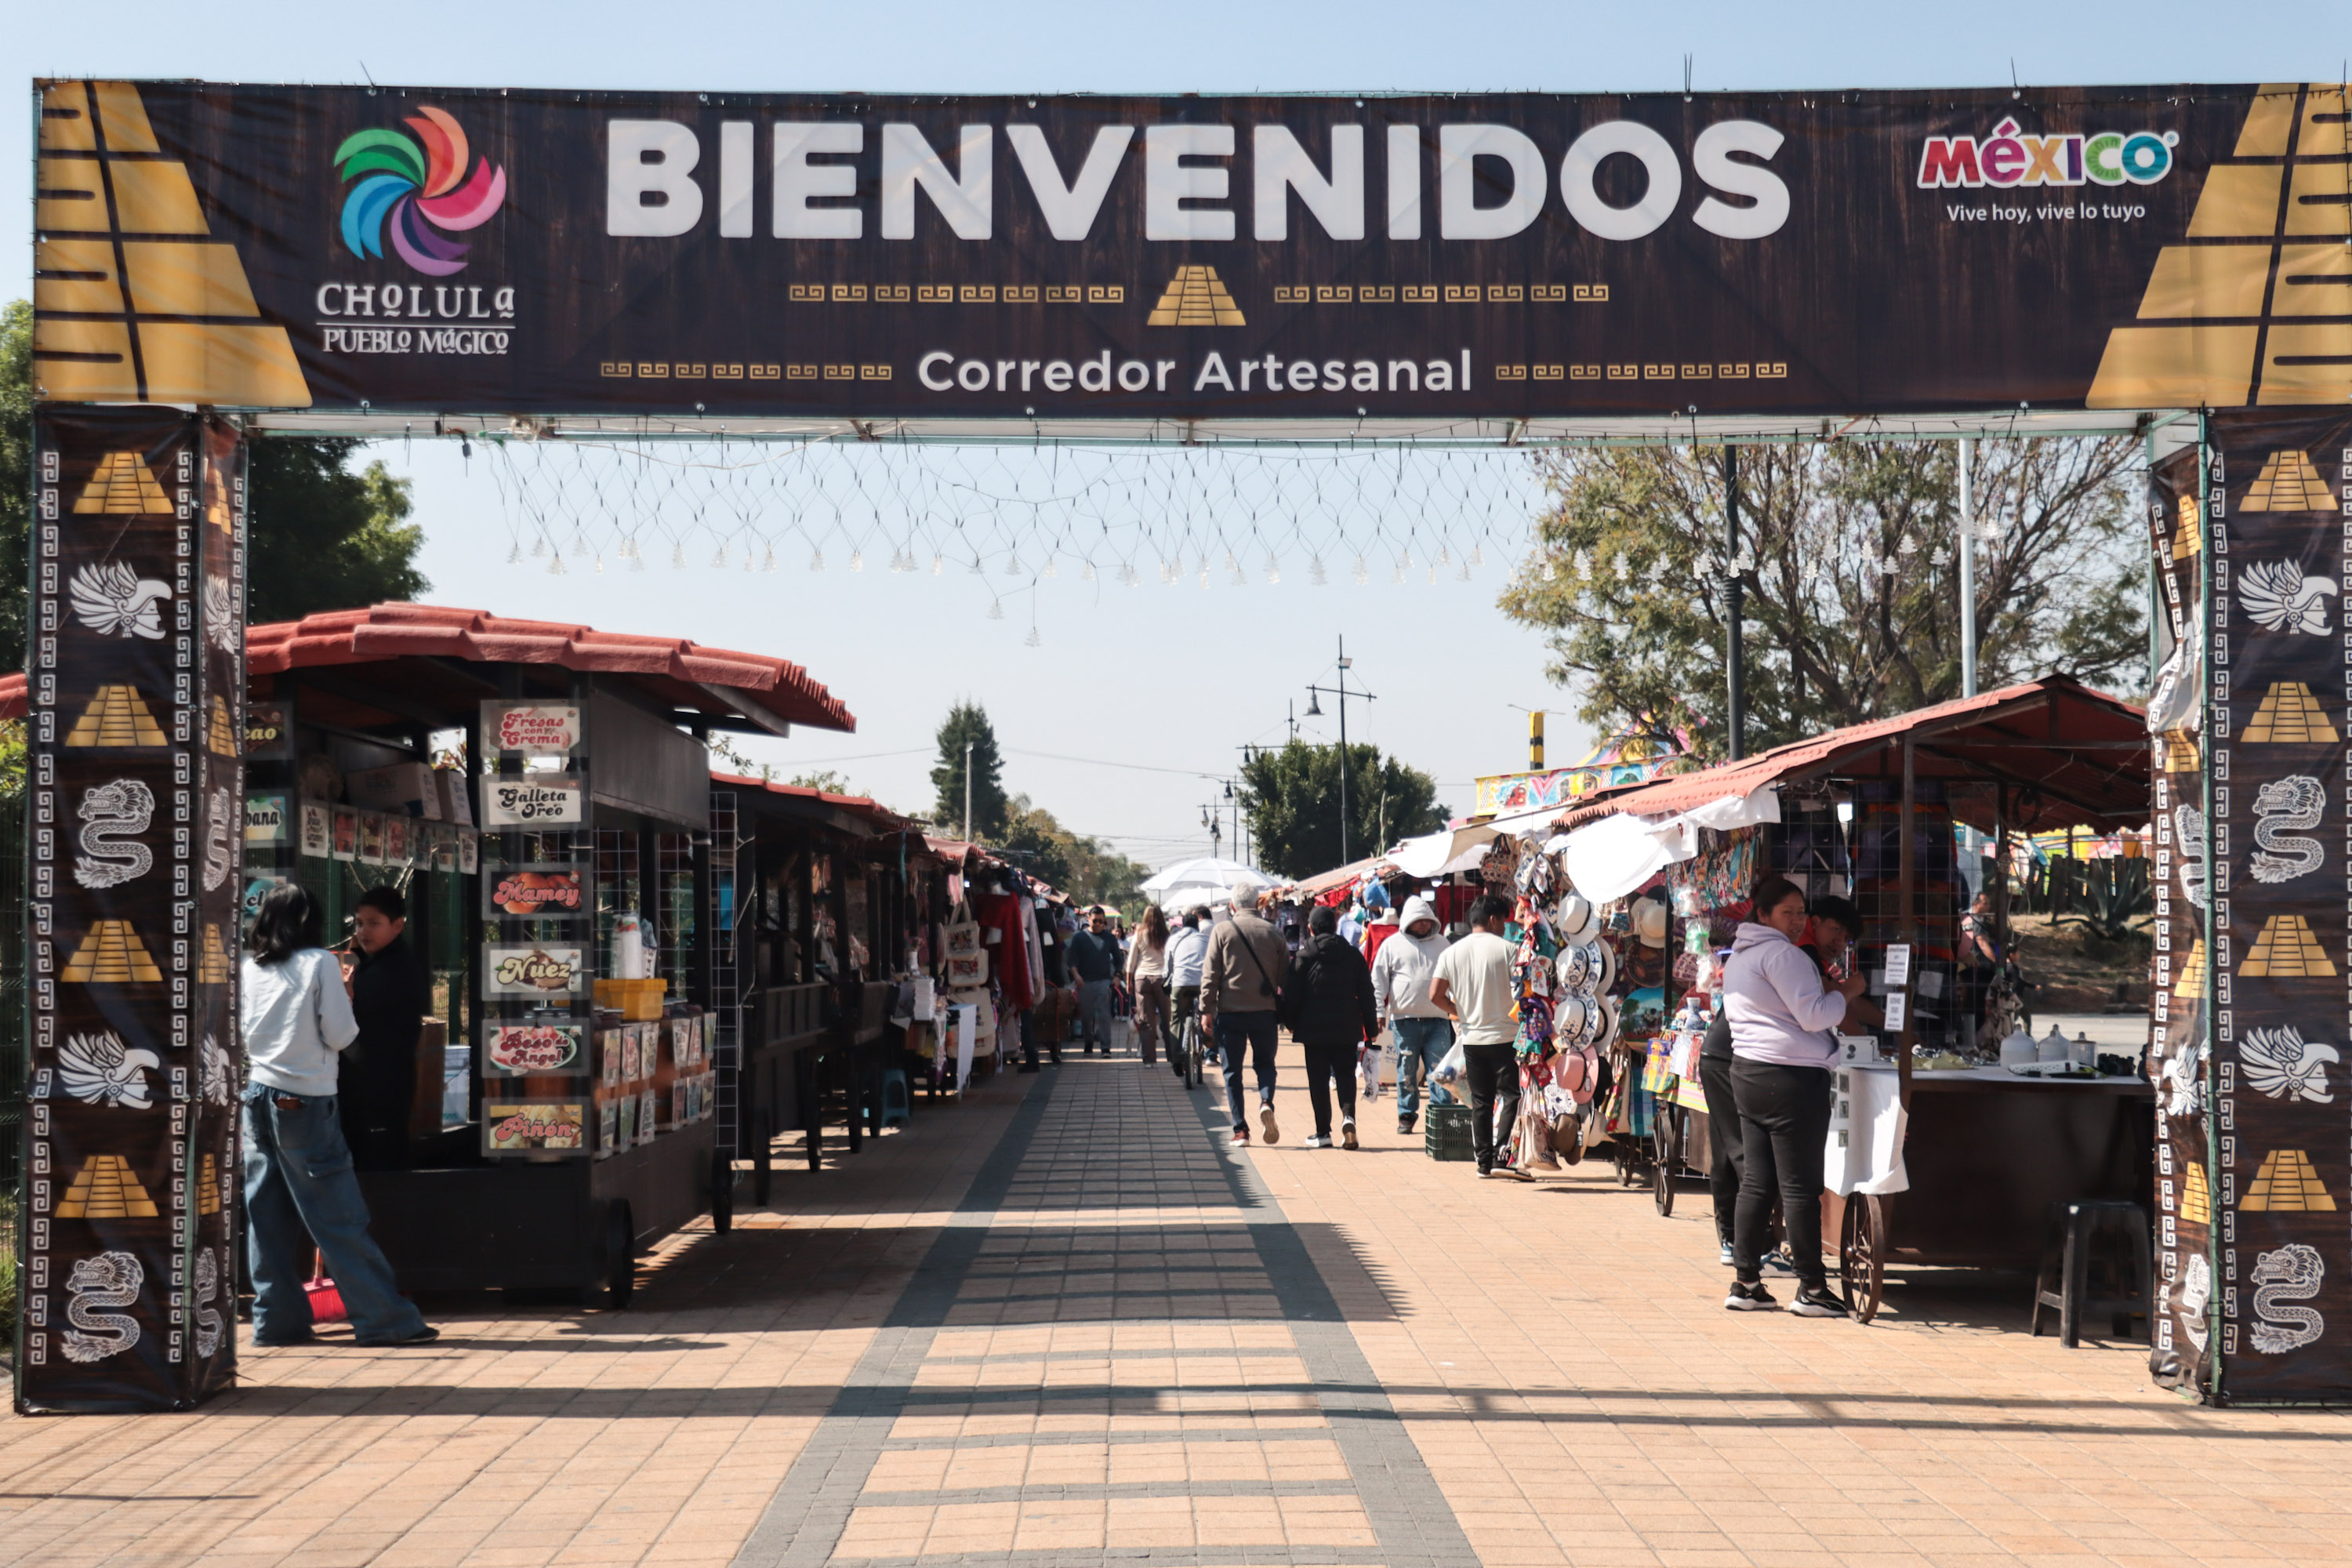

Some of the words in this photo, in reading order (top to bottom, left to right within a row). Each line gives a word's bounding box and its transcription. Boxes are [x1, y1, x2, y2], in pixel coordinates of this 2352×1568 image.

[606, 119, 1792, 243] BIENVENIDOS
[1947, 205, 1987, 222] Vive
[1993, 204, 2031, 224] hoy,
[2036, 203, 2074, 220] vive
[2080, 202, 2097, 220] lo
[2102, 204, 2146, 222] tuyo
[918, 350, 1176, 394] Corredor
[1194, 350, 1472, 394] Artesanal
[503, 713, 564, 730] Fresas
[501, 730, 561, 746] Crema
[498, 788, 568, 808] Galleta
[521, 803, 564, 818] Oreo
[493, 880, 579, 906] Mamey
[497, 956, 572, 985] Nuez
[500, 1031, 553, 1051] Beso
[555, 1036, 569, 1047] de
[510, 1050, 563, 1066] Angel
[495, 1112, 572, 1142] Piñón
